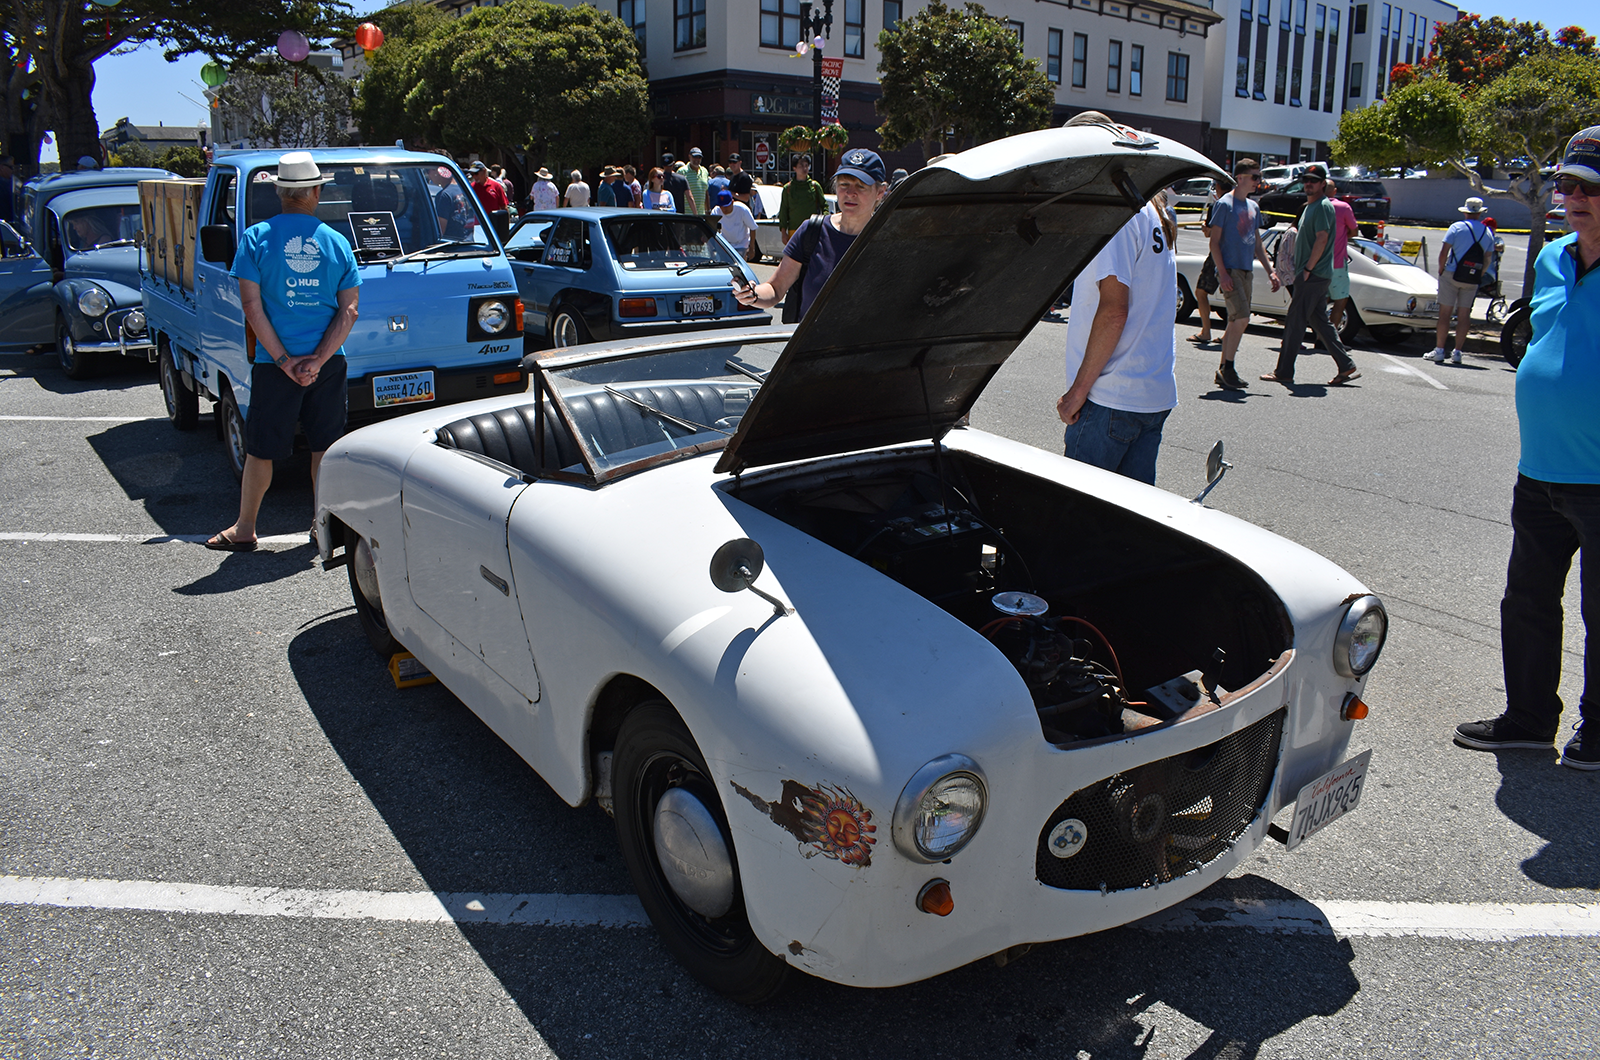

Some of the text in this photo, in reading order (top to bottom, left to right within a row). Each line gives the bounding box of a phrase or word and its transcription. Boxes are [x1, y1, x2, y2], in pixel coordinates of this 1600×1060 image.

[298, 278, 320, 287] HUB
[477, 343, 510, 355] 4WD
[388, 374, 418, 382] NEVADA
[376, 384, 401, 392] CLASSIC
[376, 392, 401, 401] VEHICLE
[1311, 767, 1356, 799] California
[1295, 774, 1362, 839] 7HJX965
